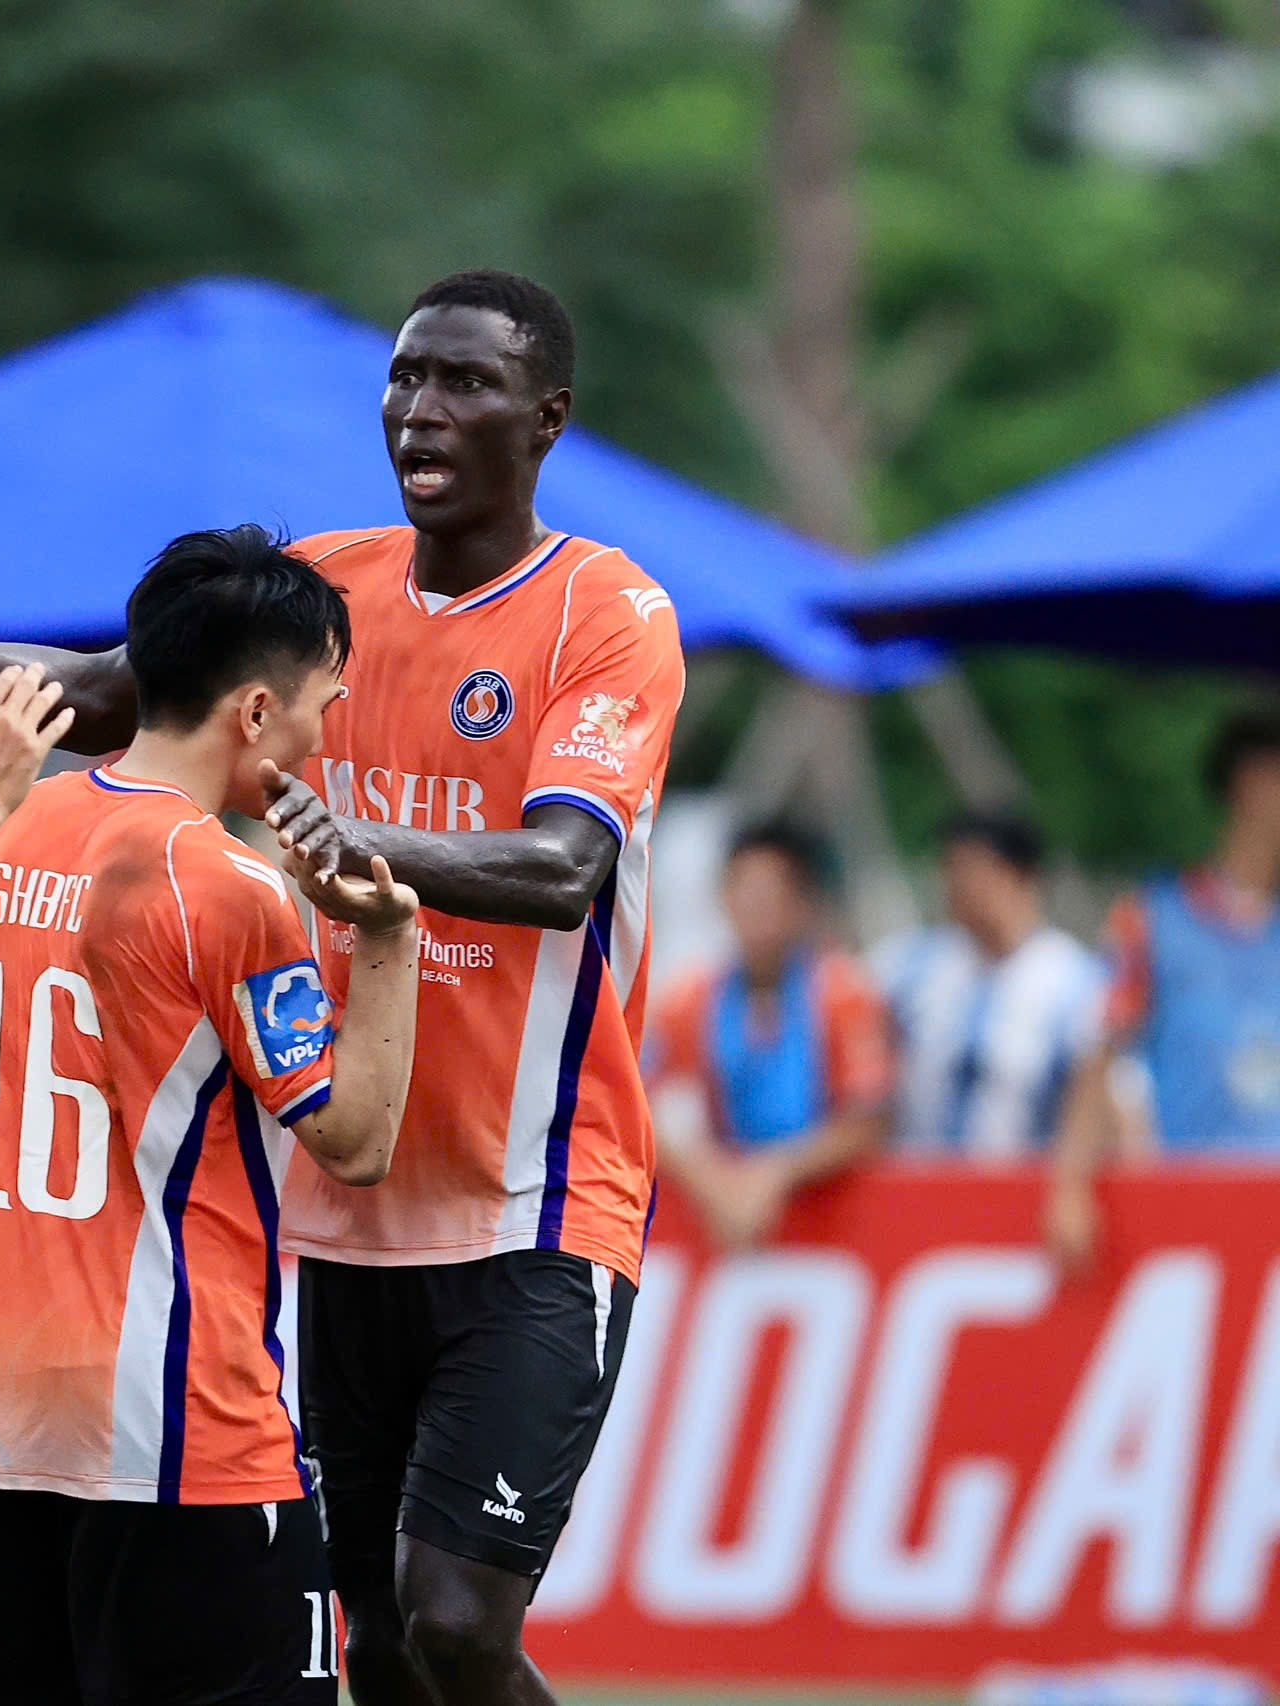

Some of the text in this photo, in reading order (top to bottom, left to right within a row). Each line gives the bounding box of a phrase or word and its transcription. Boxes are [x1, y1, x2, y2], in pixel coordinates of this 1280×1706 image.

[475, 676, 501, 692] SHB
[580, 734, 605, 748] BIA
[550, 741, 626, 778] SAIGON
[417, 926, 494, 968] Homes
[421, 969, 461, 986] BEACH
[481, 1499, 526, 1524] KAMITO
